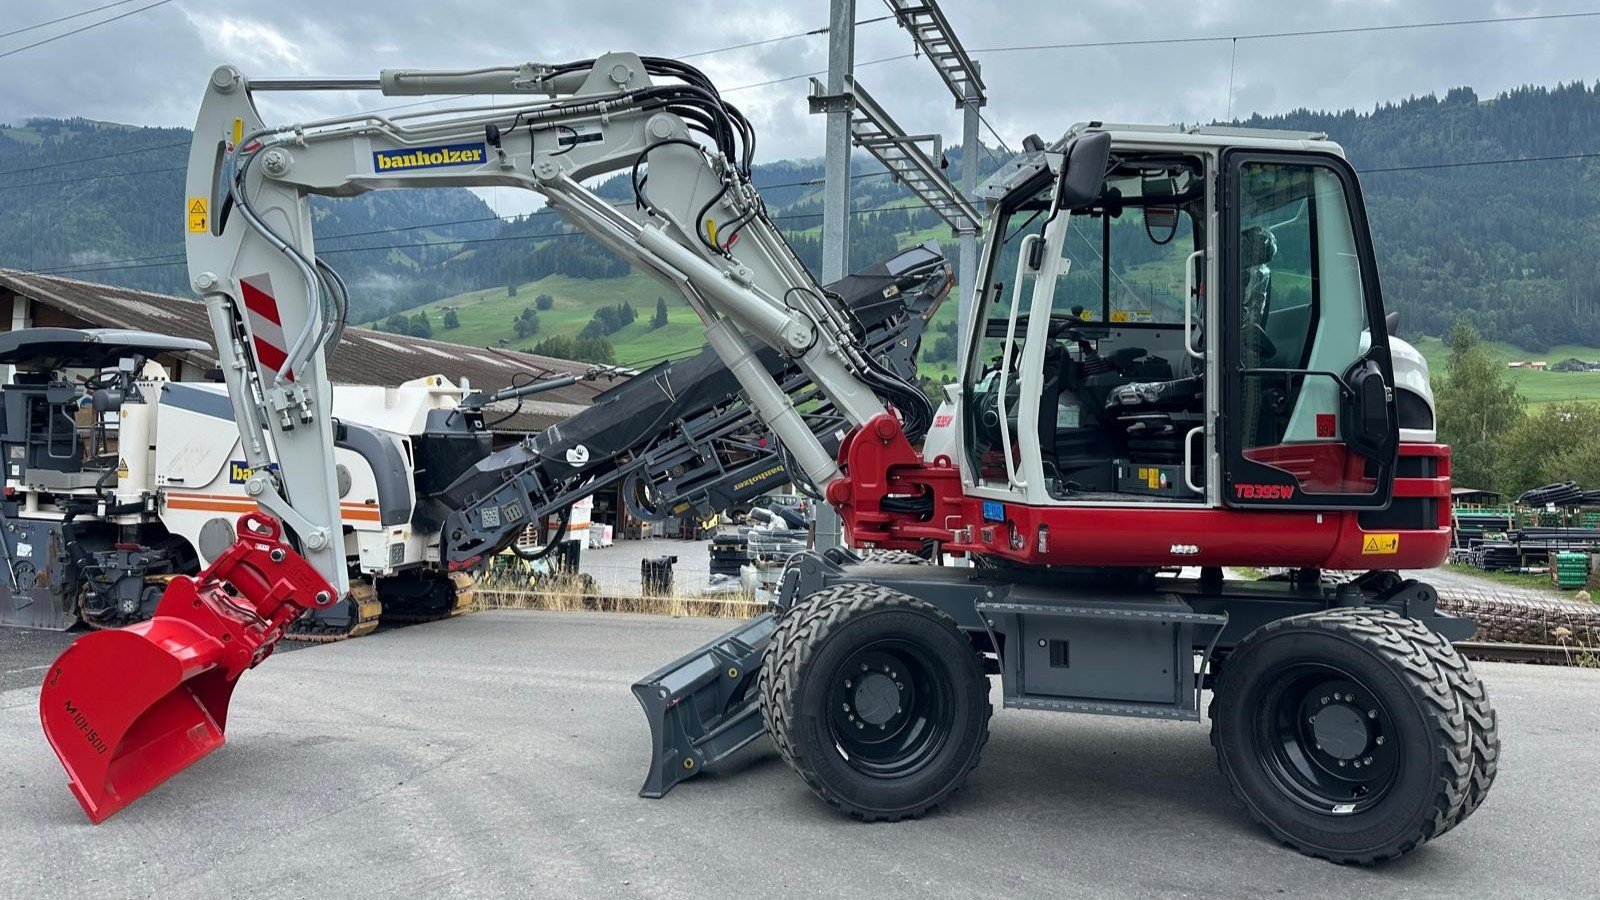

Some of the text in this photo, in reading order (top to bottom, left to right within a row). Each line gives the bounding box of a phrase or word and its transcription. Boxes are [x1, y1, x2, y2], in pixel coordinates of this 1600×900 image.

[377, 148, 482, 170] banholzer
[733, 464, 785, 491] banholzer
[1234, 484, 1296, 499] TB395W
